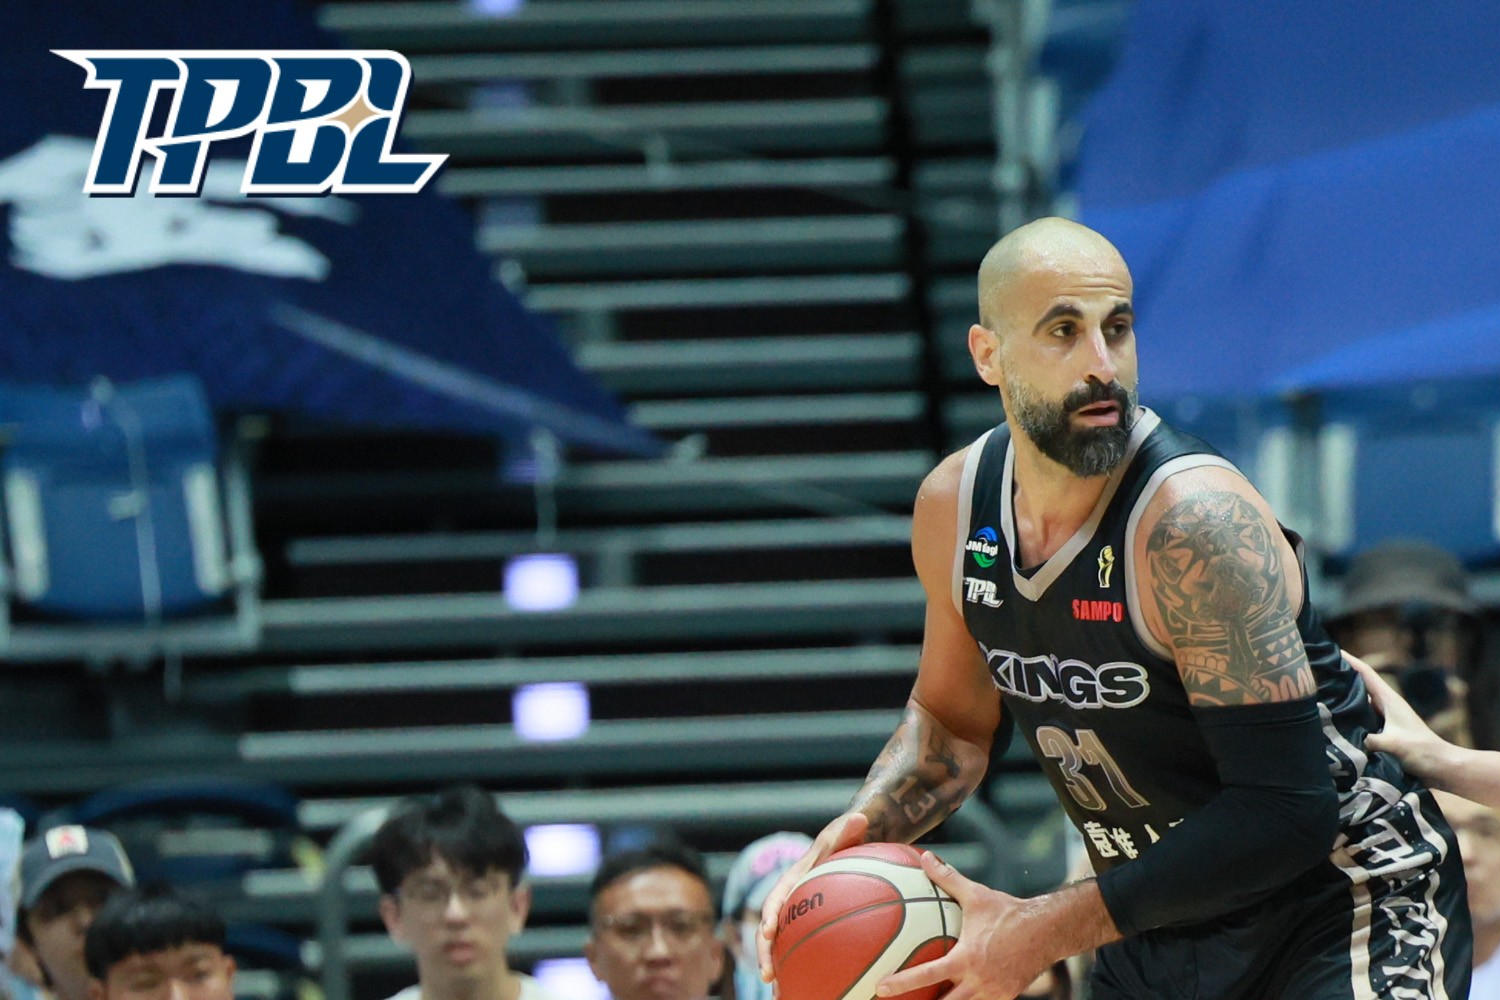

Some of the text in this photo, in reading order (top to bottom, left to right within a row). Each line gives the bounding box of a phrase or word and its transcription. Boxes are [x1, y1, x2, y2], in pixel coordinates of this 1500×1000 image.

[1072, 598, 1124, 623] SAMPO
[979, 642, 1150, 709] KINGS
[1036, 725, 1150, 811] 31
